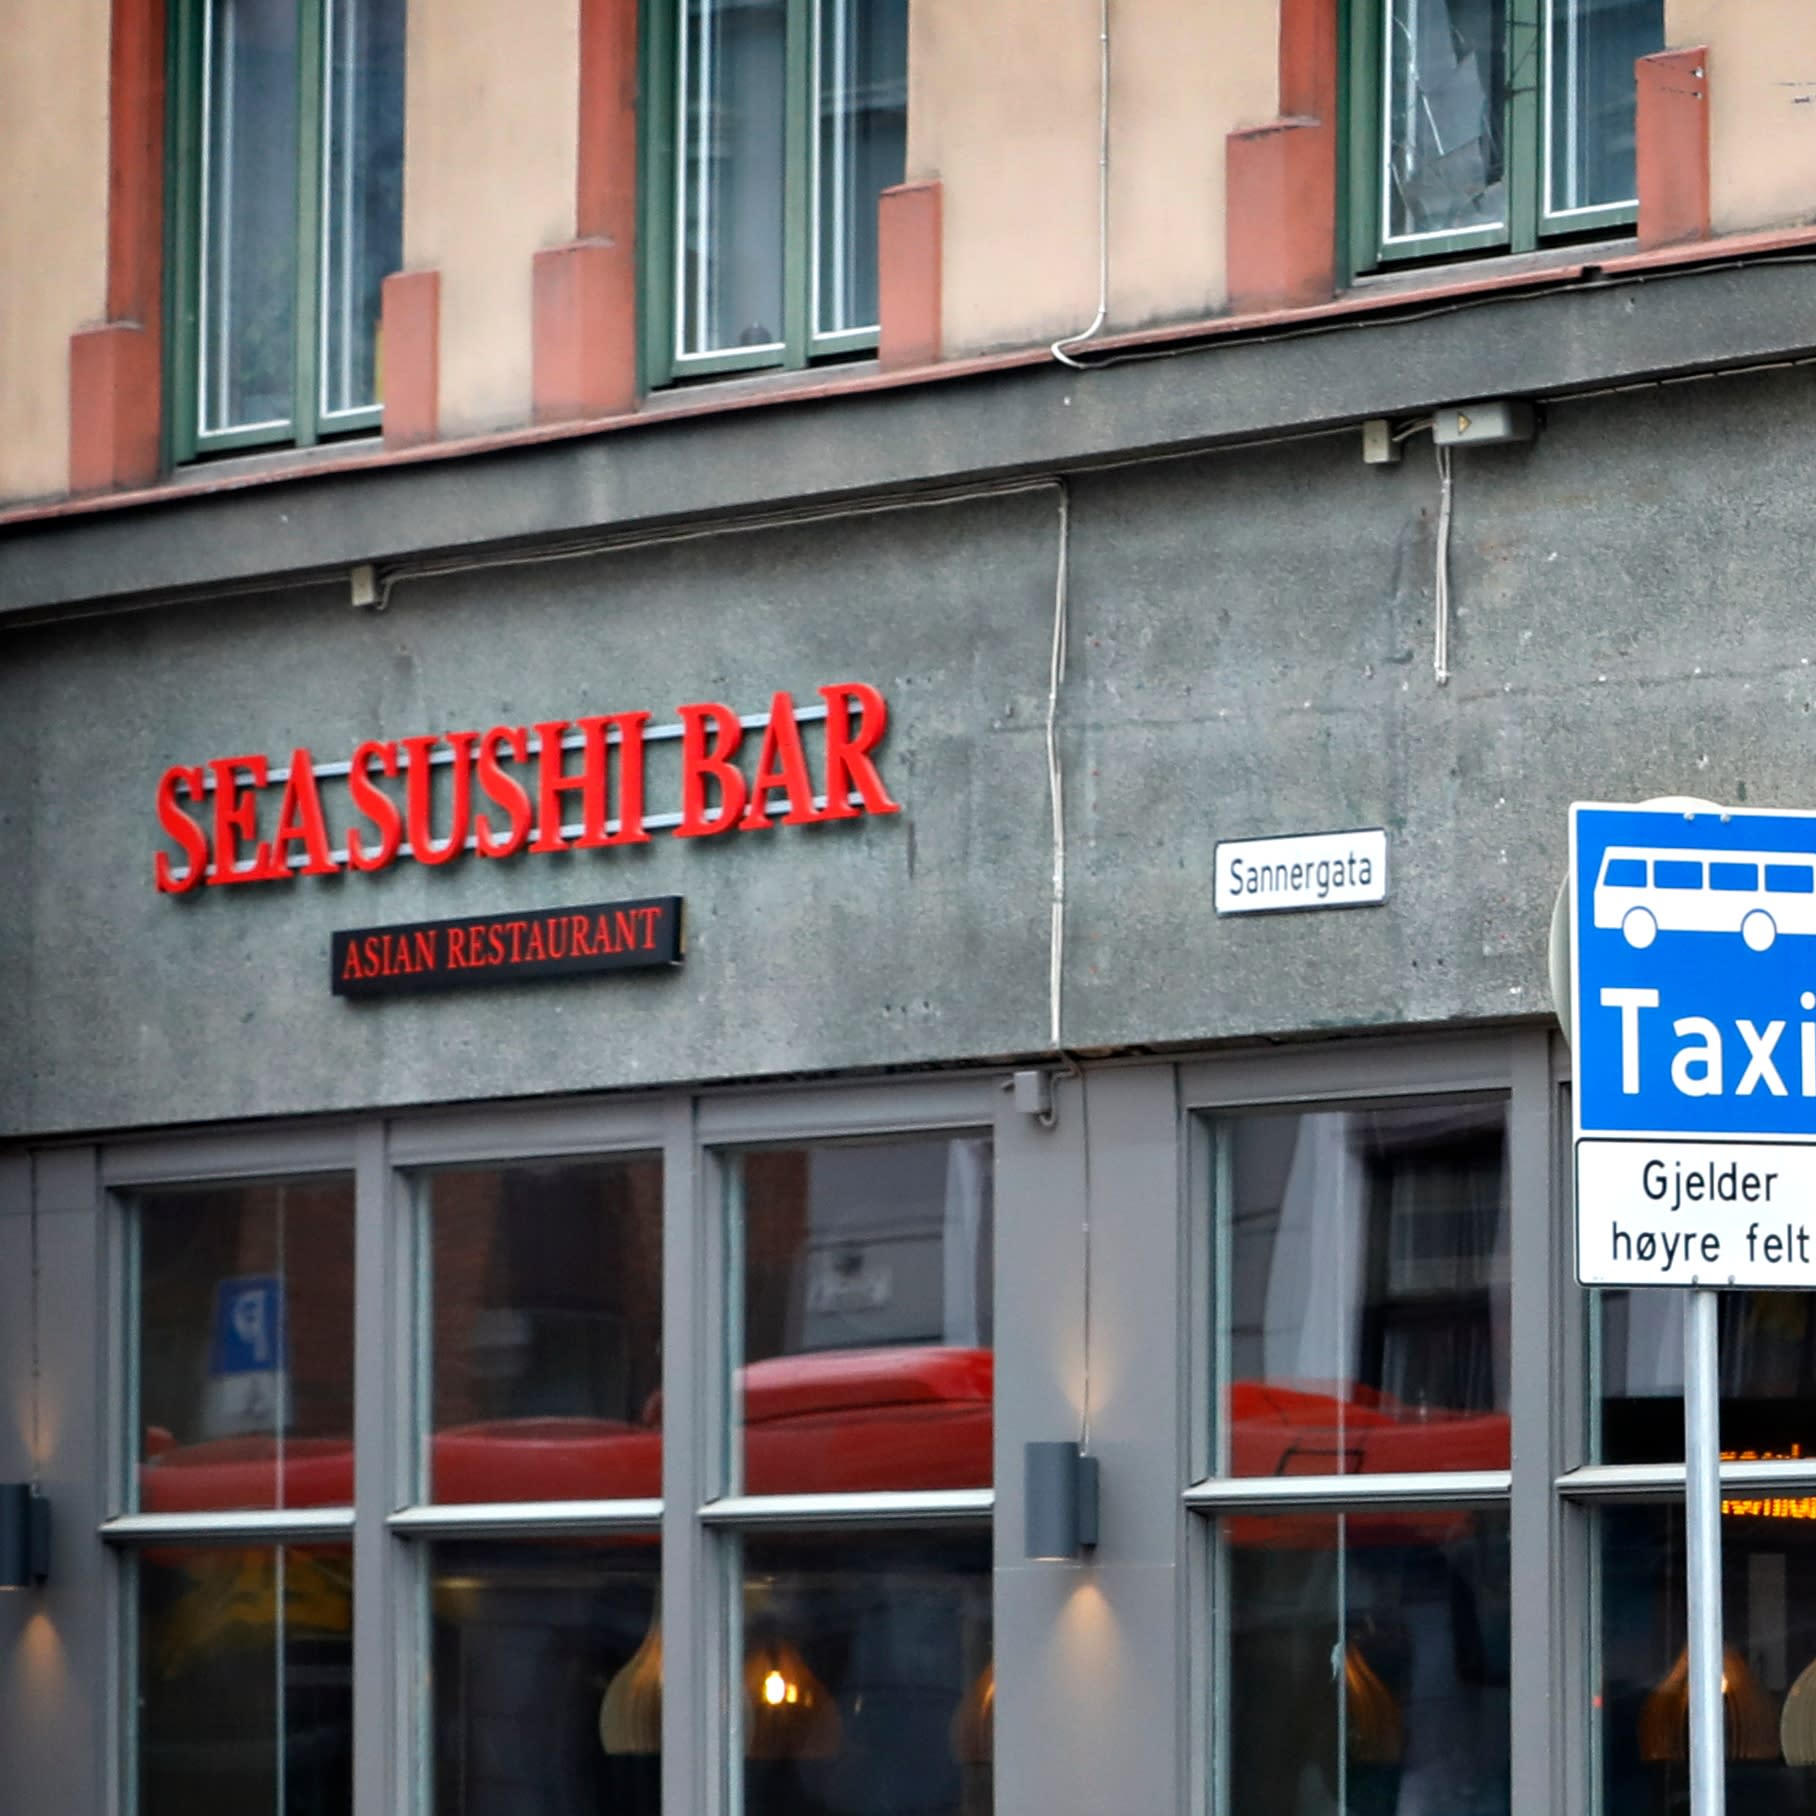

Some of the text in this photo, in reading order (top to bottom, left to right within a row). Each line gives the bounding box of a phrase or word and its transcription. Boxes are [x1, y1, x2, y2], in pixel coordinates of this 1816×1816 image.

[155, 682, 901, 895] SEA SUSHI BAR
[1229, 856, 1374, 900] Sannergata
[342, 906, 663, 980] ASIAN RESTAURANT
[1643, 1159, 1778, 1212] Gjelder
[1611, 1223, 1811, 1272] høyre felt
